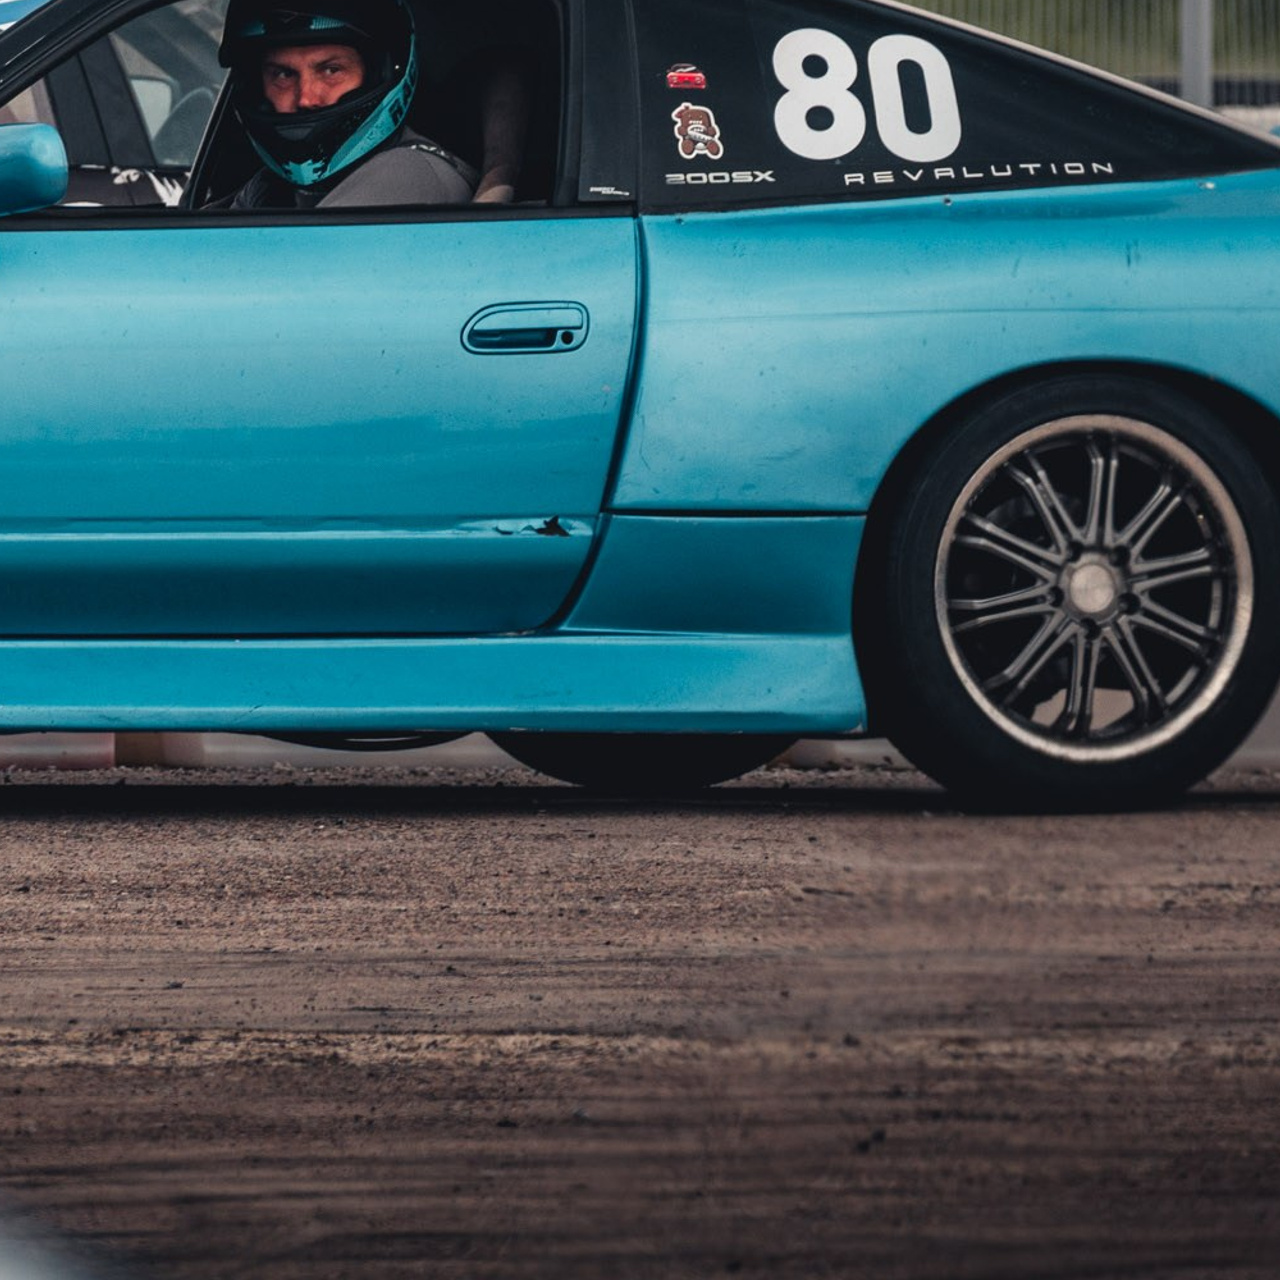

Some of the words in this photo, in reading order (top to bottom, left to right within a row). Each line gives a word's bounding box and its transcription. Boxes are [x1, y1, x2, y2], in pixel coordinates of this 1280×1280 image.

[772, 28, 962, 162] 80
[665, 170, 776, 184] 200SX
[845, 162, 1114, 185] REVALUTION
